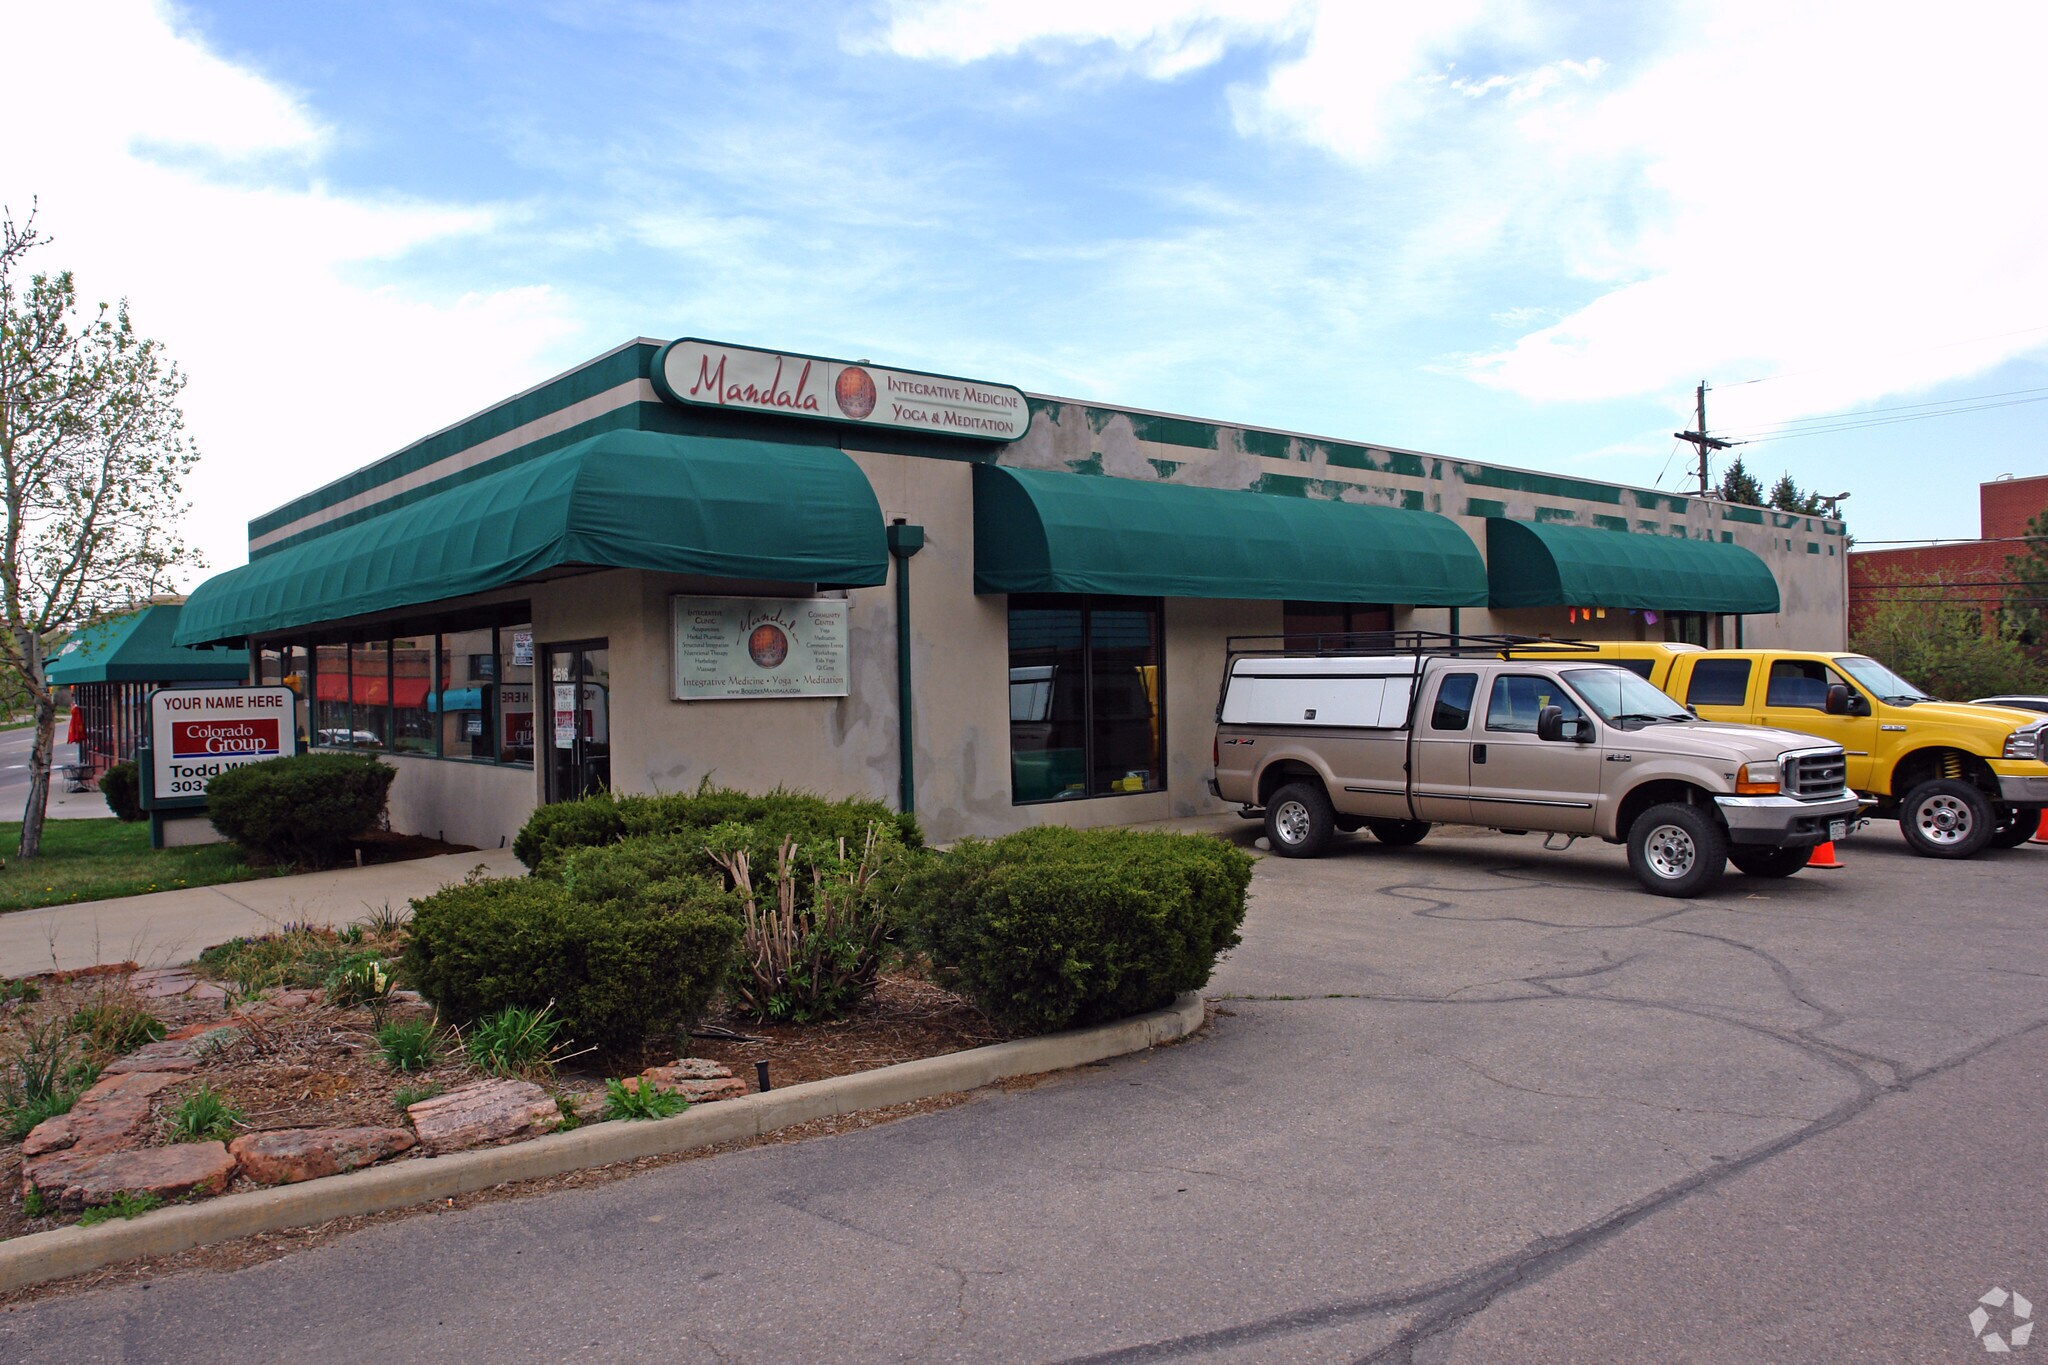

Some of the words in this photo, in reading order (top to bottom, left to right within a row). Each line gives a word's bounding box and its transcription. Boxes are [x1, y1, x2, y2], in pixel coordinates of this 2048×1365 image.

[690, 354, 820, 412] Mandala
[887, 375, 960, 400] INTEGRATIVE
[960, 386, 1018, 408] MEDICINE
[891, 403, 928, 423] YOGA
[931, 411, 940, 424] &
[942, 410, 1014, 433] MEDITATION
[736, 608, 799, 646] Mandala
[814, 618, 835, 626] CENTER
[683, 677, 726, 688] Integrative
[728, 676, 764, 686] Medicine
[772, 675, 792, 688] Yoga
[803, 675, 844, 685] Meditation
[164, 697, 201, 710] YOUR
[206, 696, 243, 709] NAME
[248, 695, 283, 708] HERE
[187, 724, 254, 739] Colorado
[205, 736, 267, 755] Group
[169, 763, 220, 778] Todd
